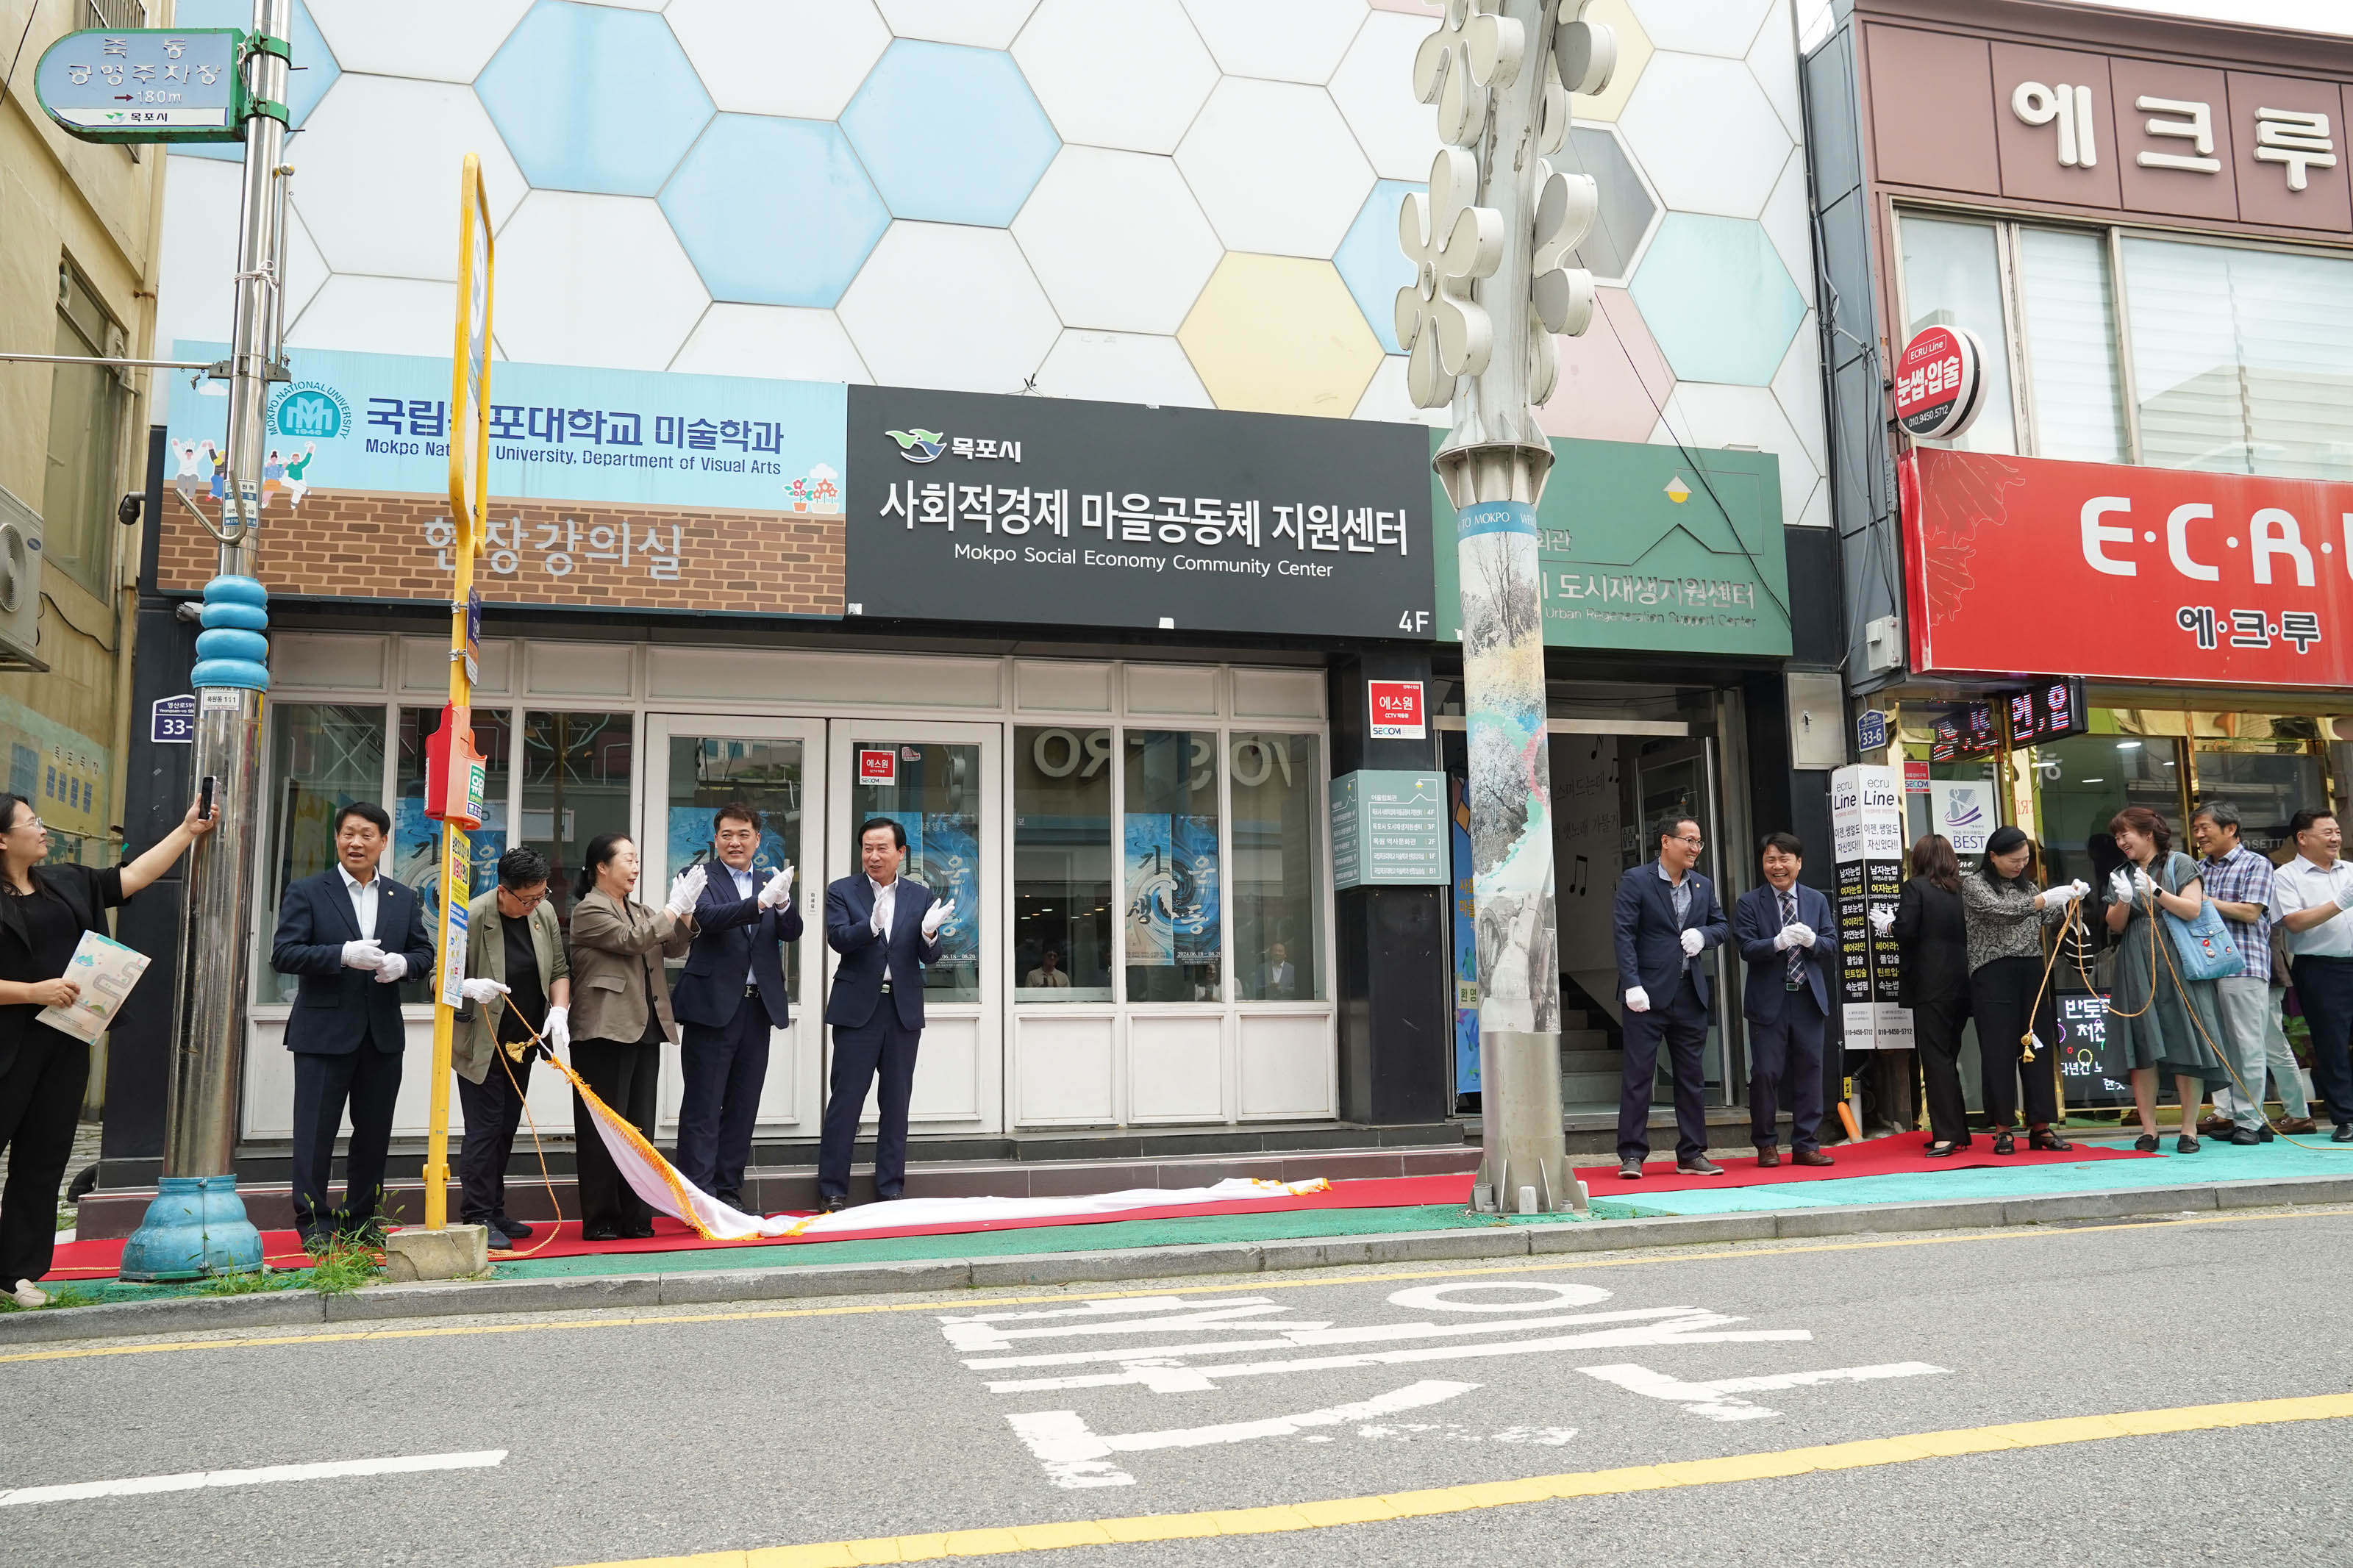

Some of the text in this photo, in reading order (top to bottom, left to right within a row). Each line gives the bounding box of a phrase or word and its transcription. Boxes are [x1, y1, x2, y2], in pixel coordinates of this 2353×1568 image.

[68, 64, 221, 86] 공영주차장
[137, 90, 182, 104] 180m
[131, 112, 168, 123] 목포시
[2011, 82, 2337, 191] 에크루
[1910, 341, 1943, 360] ECRU Line
[267, 381, 352, 440] MOKPO NATIONAL UNIVERSITY
[1908, 404, 1949, 427] 010.9450.5712
[368, 397, 785, 454] 국립포대학교 미술학과
[366, 438, 781, 475] Mokpo Natl University, Department of Visual Arts
[952, 437, 1022, 464] 목포시
[880, 479, 1408, 556] 사회적경제 마을공동체 지원센터
[1463, 517, 1471, 529] TO
[1474, 512, 1511, 525] MOKPO
[955, 543, 1334, 578] Mokpo Social Economy Community Center
[1558, 573, 1755, 609] 도시재생지원센터
[1399, 610, 1429, 633] 4F
[1545, 606, 1757, 629] Urban Regeneration Support Center
[1379, 695, 1413, 710] 에스원
[163, 719, 193, 734] 33-
[1373, 727, 1402, 735] SECOM
[1863, 728, 1882, 745] 33-6
[866, 759, 888, 768] 에스원
[1836, 781, 1852, 792] ecru
[1868, 779, 1890, 788] ecru
[1835, 794, 1857, 810] Line
[1864, 790, 1895, 806] Line
[1837, 840, 1860, 853] 자신있다!!
[1868, 840, 1899, 850] 자신있다!!
[1954, 835, 1985, 848] BEST
[1839, 866, 1861, 878] 남자눈썹
[1870, 865, 1899, 876] 남자눈썹
[1840, 884, 1862, 895] 여자눈썹
[1871, 883, 1899, 893] 여자눈썹
[1842, 903, 1864, 914] 콤보눈썹
[1842, 915, 1864, 927] 아이라인
[1843, 928, 1865, 940] 자연눈썹
[1843, 942, 1865, 953] 헤어라인
[1846, 955, 1864, 966] 풀입술
[1879, 954, 1899, 964] 풀입술
[1844, 967, 1867, 978] 틴트입술
[1877, 967, 1899, 977] 틴트입
[1846, 981, 1868, 992] 속눈썹펌
[1878, 980, 1899, 990] 속눈썹
[1878, 1028, 1913, 1036] 010-9450-5712
